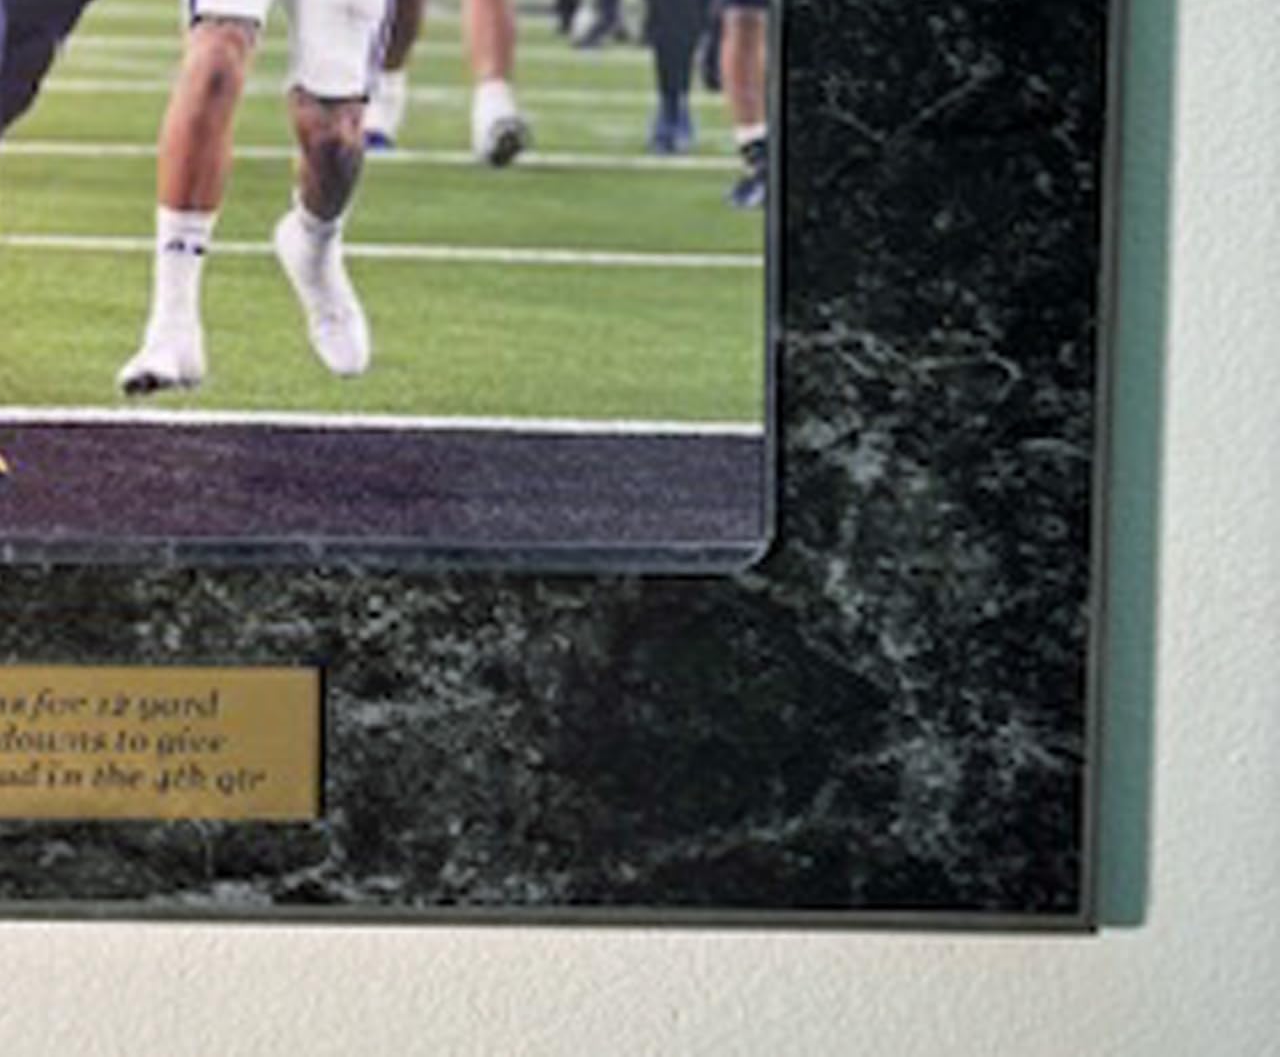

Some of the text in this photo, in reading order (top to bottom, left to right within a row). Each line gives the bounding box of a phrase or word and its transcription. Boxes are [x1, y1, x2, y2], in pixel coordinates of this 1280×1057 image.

[31, 687, 88, 721] for
[95, 694, 131, 716] 12
[137, 689, 220, 722] yard
[115, 730, 150, 753] to
[155, 725, 228, 756] give
[47, 762, 84, 788] in
[92, 762, 146, 789] the
[154, 762, 208, 794] 4th
[215, 768, 268, 795] qtr
